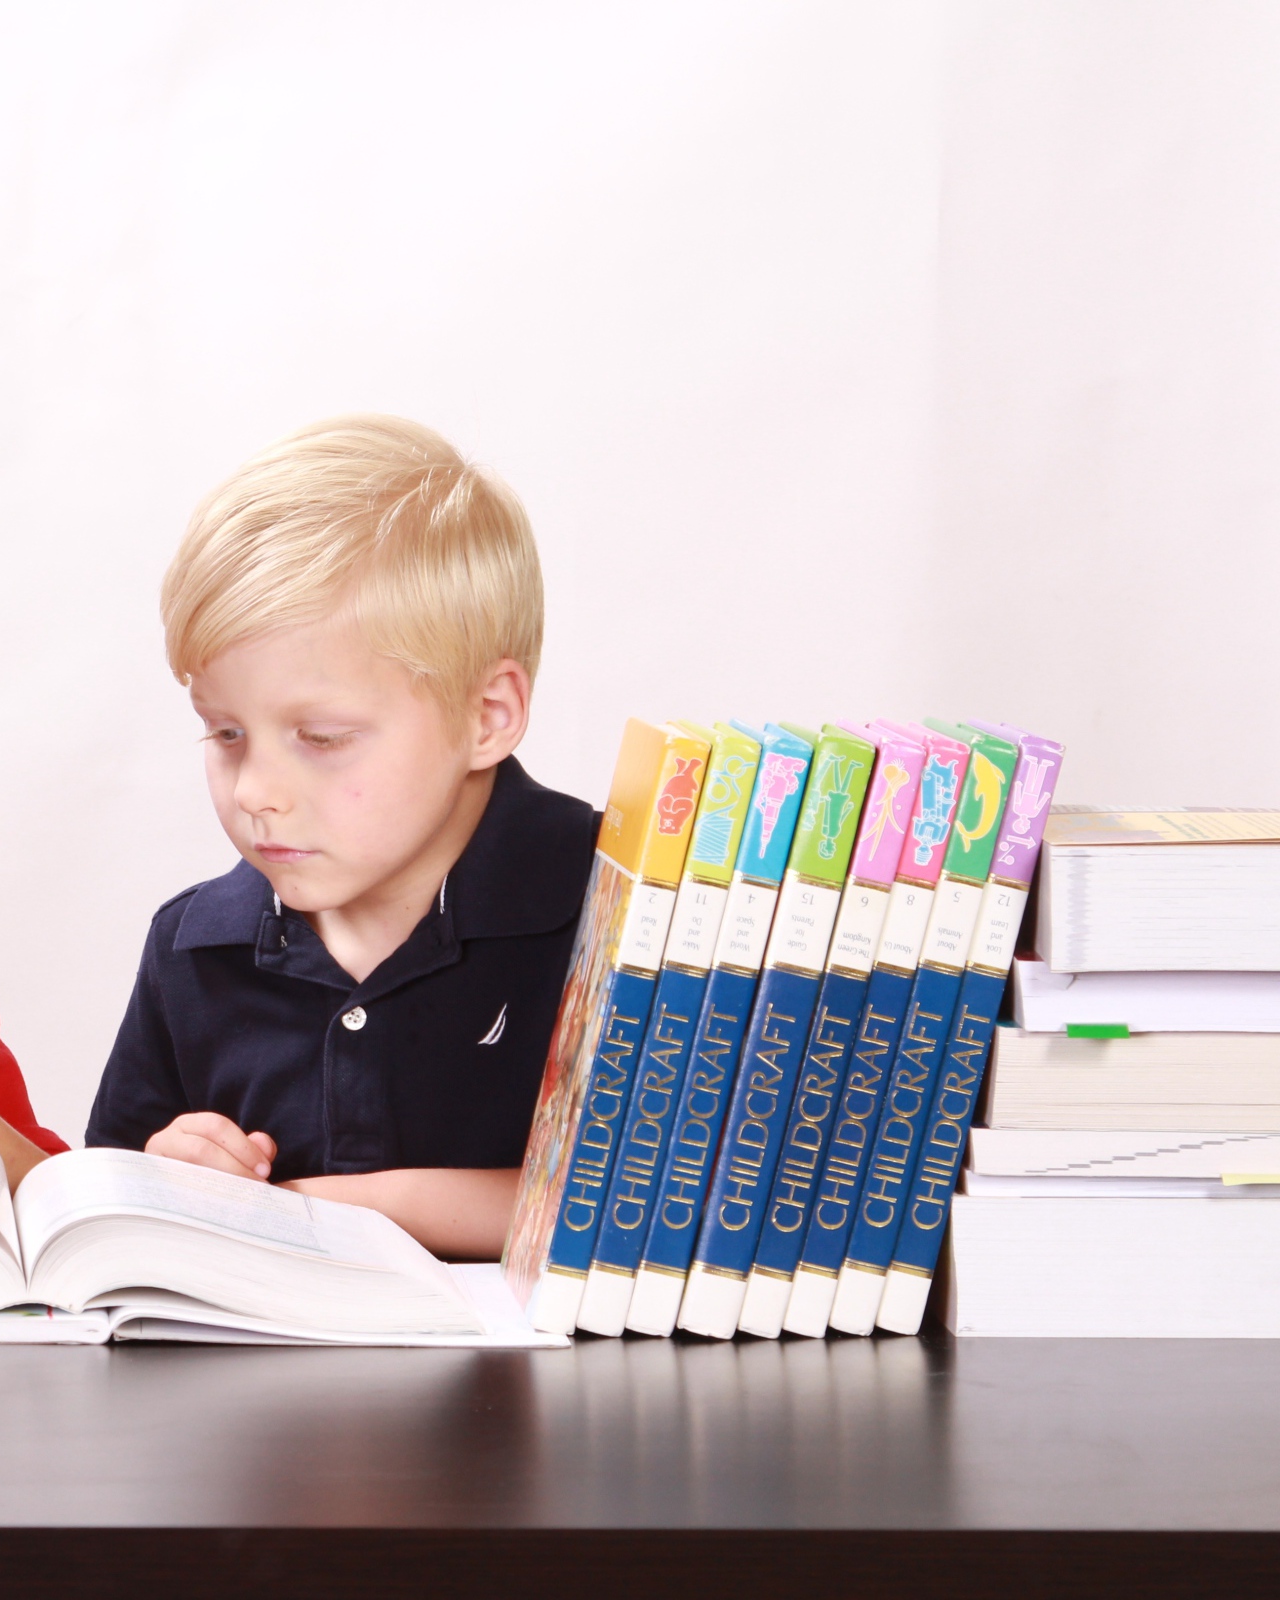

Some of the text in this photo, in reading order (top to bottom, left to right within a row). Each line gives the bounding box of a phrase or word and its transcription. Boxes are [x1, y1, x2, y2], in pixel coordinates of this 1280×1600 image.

[648, 892, 657, 904] 2
[694, 892, 708, 905] 11
[747, 892, 756, 904] 4
[801, 892, 815, 906] 15
[860, 896, 869, 908] 6
[906, 894, 916, 906] 8
[952, 891, 962, 903] 5
[997, 894, 1012, 907] 12
[640, 915, 658, 927] Read
[692, 916, 703, 926] Do
[736, 915, 756, 928] Space
[791, 914, 816, 928] Parents
[990, 918, 1009, 931] Learn
[642, 929, 651, 938] to
[687, 928, 700, 938] and
[736, 929, 749, 938] and
[795, 928, 806, 938] for
[842, 931, 872, 946] Kingdom
[937, 926, 963, 940] Animals
[990, 931, 1004, 941] and
[635, 940, 652, 952] Time
[682, 941, 700, 952] Make
[729, 940, 751, 953] World
[786, 939, 808, 952] Guide
[837, 943, 871, 959] The Green
[884, 940, 914, 955] About Us
[936, 940, 958, 952] About
[986, 944, 1002, 955] Look
[563, 1004, 641, 1232] CHILDCRAFT
[612, 1003, 690, 1230] CHILDCRAFT
[661, 1003, 738, 1230] CHILDCRAFT
[718, 1002, 796, 1232] CHILDCRAFT
[771, 1005, 851, 1233] CHILDCRAFT
[816, 1003, 896, 1230] CHILDCRAFT
[862, 1001, 943, 1228] CHILDCRAFT
[912, 1004, 991, 1230] CHILDCRAFT
